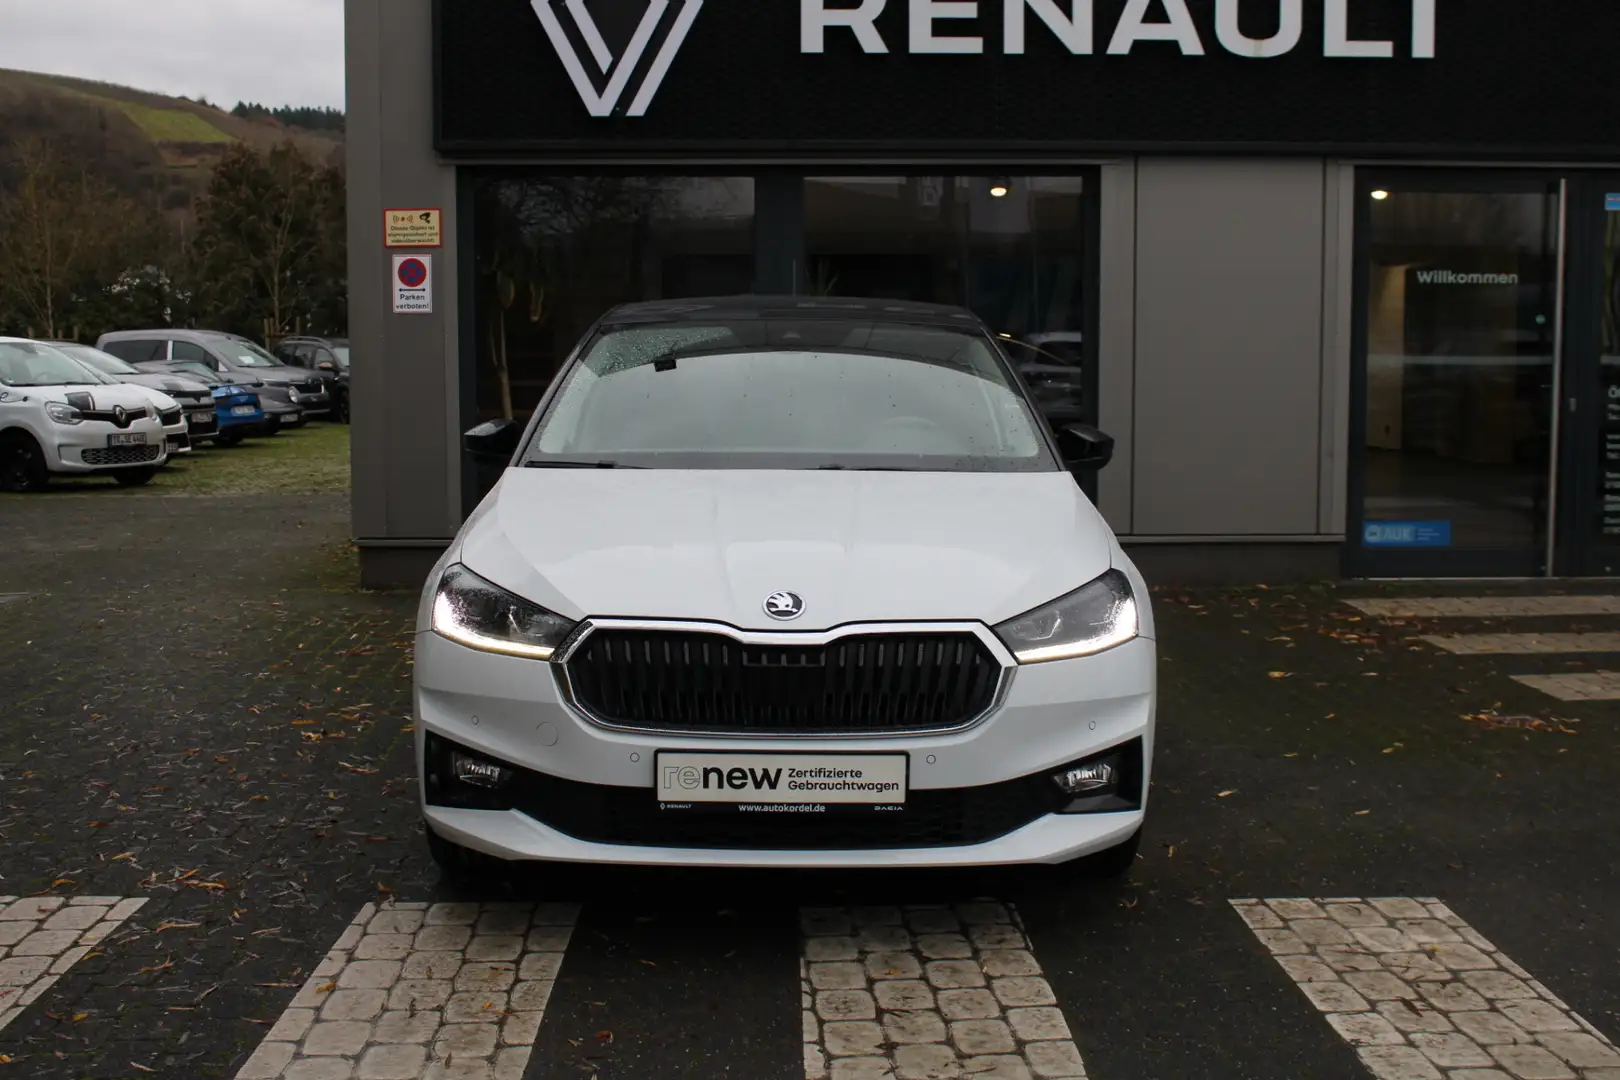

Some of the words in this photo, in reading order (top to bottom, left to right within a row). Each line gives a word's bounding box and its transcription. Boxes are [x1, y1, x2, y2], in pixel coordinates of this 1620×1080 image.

[1416, 270, 1518, 284] Willkommen
[662, 765, 783, 790] renew
[788, 767, 863, 779] Zertifizierte
[788, 779, 899, 793] Gebrauchtwagen
[738, 803, 826, 812] www.autokordel.de
